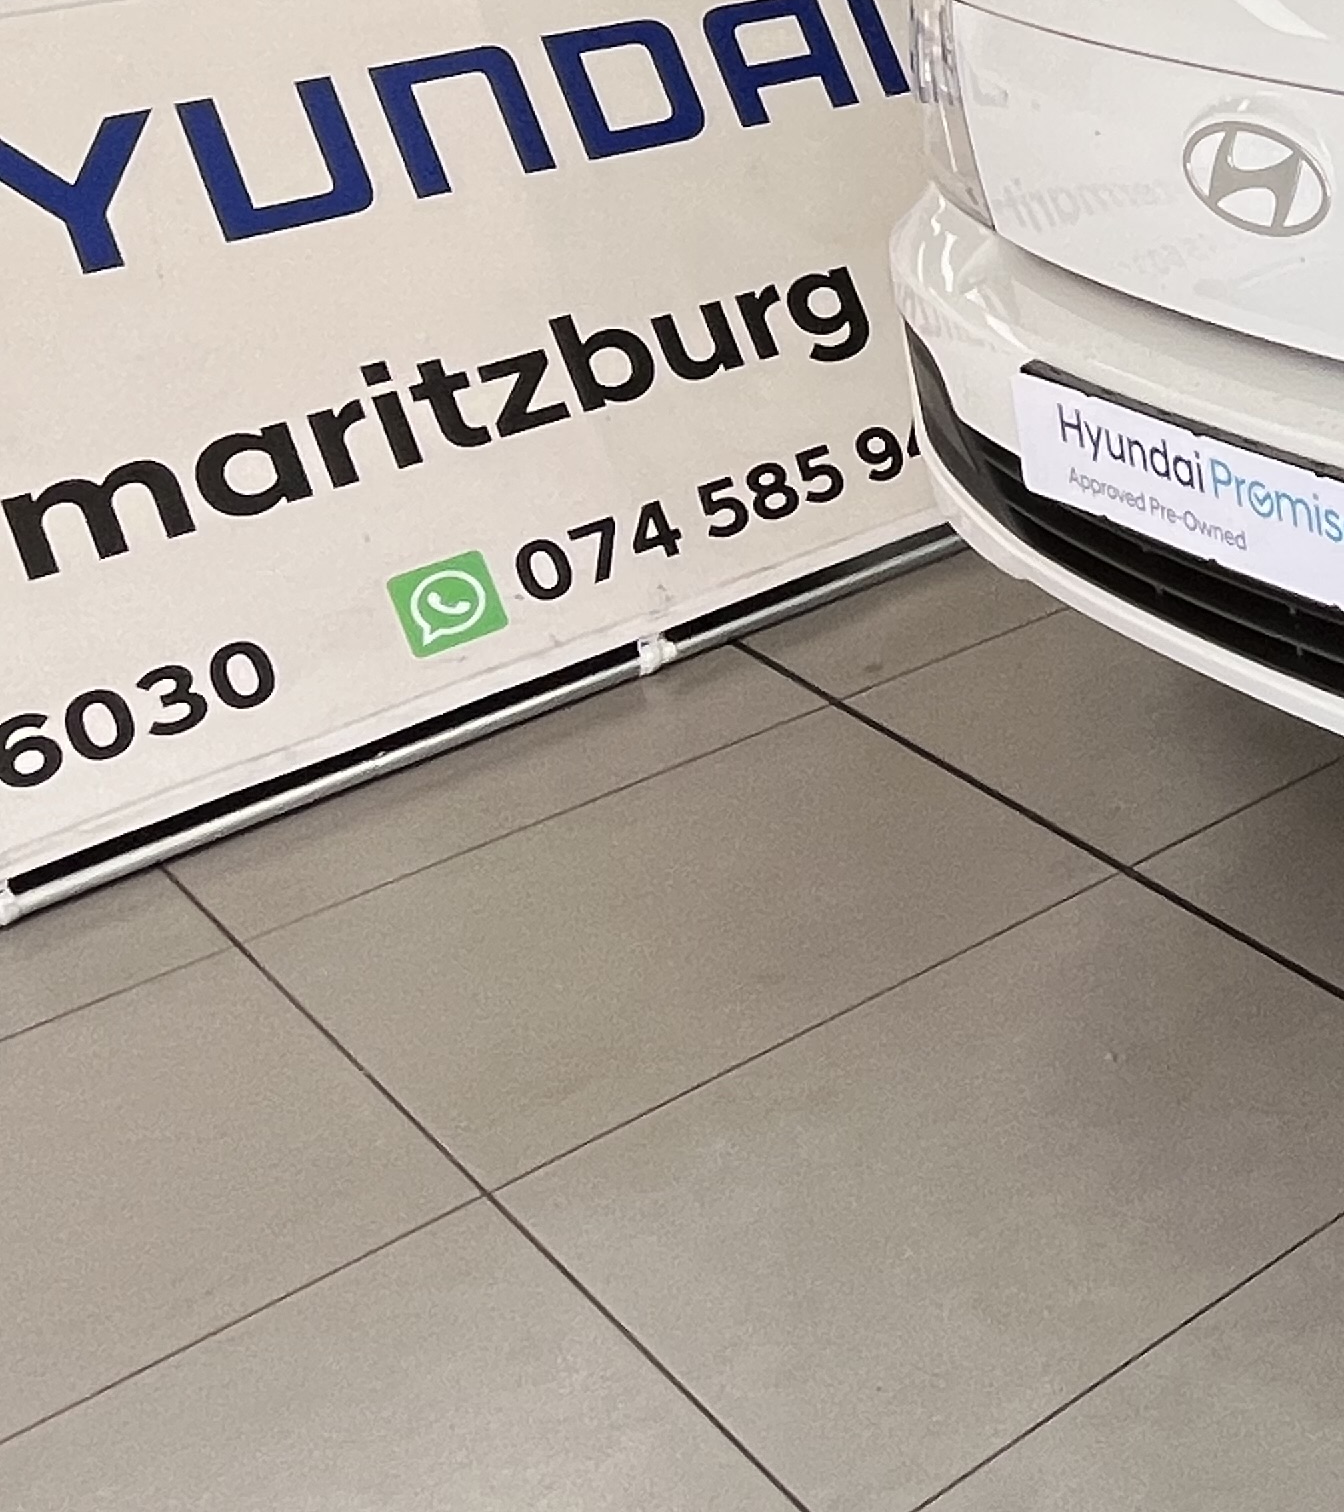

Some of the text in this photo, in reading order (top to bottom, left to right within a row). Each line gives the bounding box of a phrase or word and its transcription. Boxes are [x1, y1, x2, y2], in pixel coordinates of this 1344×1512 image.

[2, 266, 871, 581] maritzburg
[514, 500, 682, 601] 074
[697, 443, 845, 539] 585
[1068, 465, 1248, 552] Approved Pre-Owned
[0, 640, 277, 789] 6030
